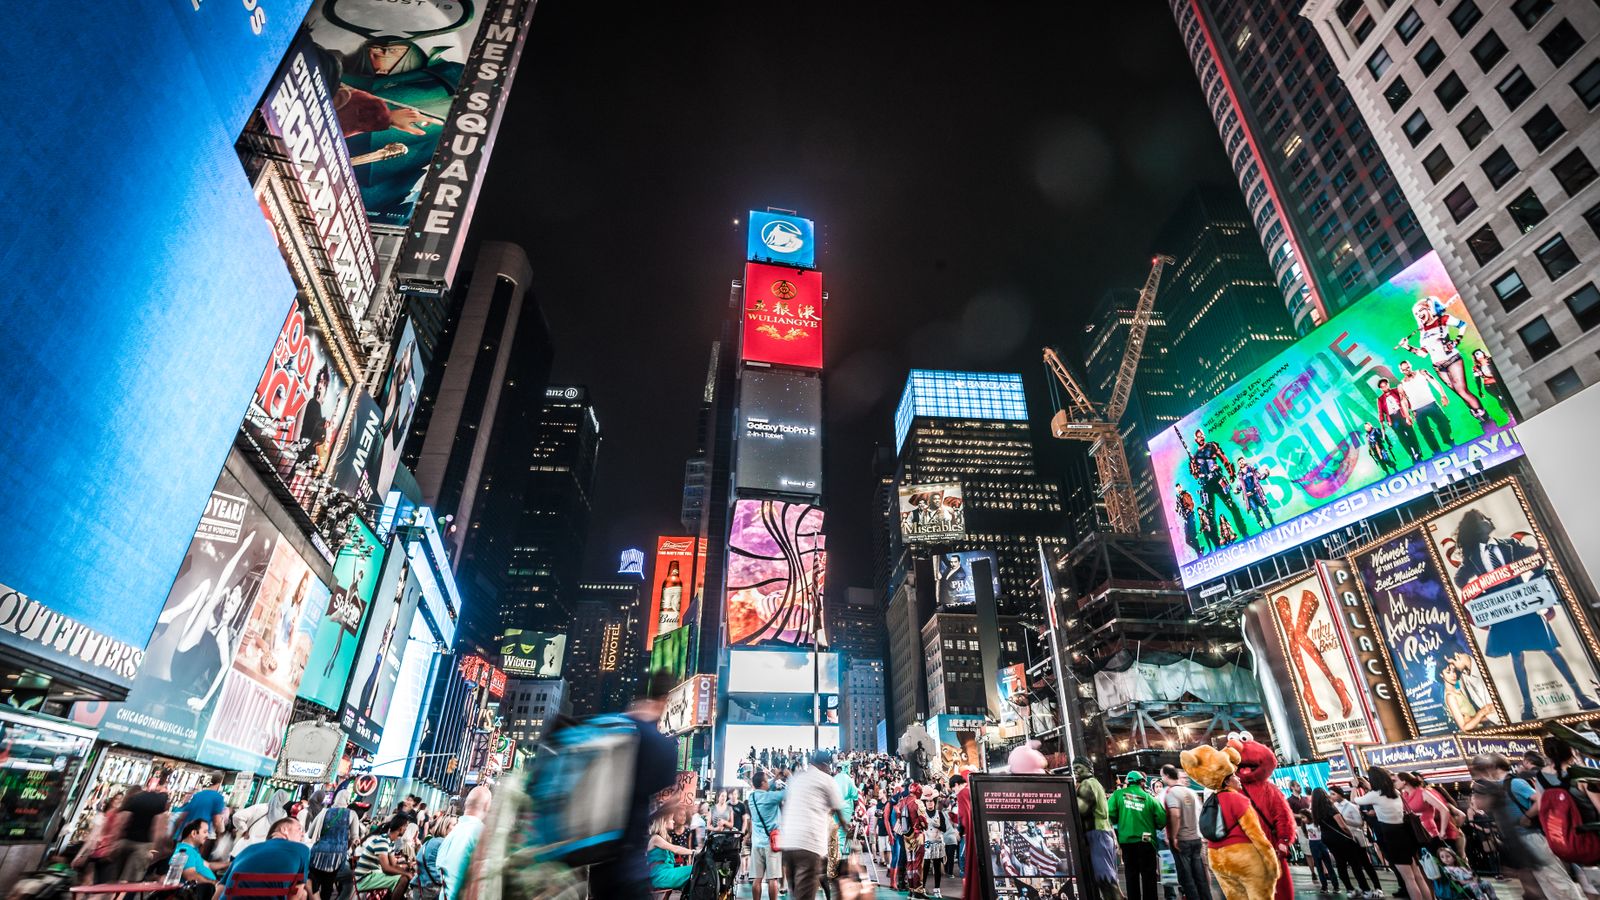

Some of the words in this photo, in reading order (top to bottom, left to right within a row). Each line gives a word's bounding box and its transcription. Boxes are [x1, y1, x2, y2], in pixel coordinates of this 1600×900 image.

[477, 0, 517, 80] IMES
[270, 72, 299, 129] THE
[313, 66, 327, 101] TONY
[322, 98, 338, 139] AWARD
[293, 52, 325, 137] CYNTHIA
[319, 127, 341, 185] ERIVO
[282, 99, 337, 238] COLOR
[424, 91, 492, 235] SQUARE
[414, 251, 441, 261] NYC
[748, 313, 818, 328] WULIANGYE
[967, 380, 1016, 390] BARCLAYS
[747, 422, 778, 433] Galaxy
[353, 410, 379, 478] NEW
[212, 497, 245, 521] YEARS
[1184, 543, 1247, 578] EXPERIENCE
[1246, 539, 1257, 552] IT
[1259, 533, 1273, 549] IN
[1275, 506, 1331, 541] IMAX
[1333, 493, 1368, 517] 3D
[1370, 466, 1428, 502] NOW
[1371, 538, 1409, 568] Winner!
[1374, 575, 1394, 592] Best
[1393, 561, 1426, 583] Musical!
[1462, 584, 1481, 600] FINAL
[1478, 567, 1511, 589] MONTHS
[1387, 590, 1408, 621] An
[1470, 595, 1506, 613] PEDESTRIAN
[1505, 590, 1523, 602] FLOW
[1523, 583, 1542, 596] ZONE
[1384, 606, 1457, 649] American
[1475, 612, 1489, 623] KEEP
[1490, 605, 1513, 618] MOVING
[0, 591, 142, 680] OUTFITTERS
[606, 623, 621, 671] NOVOTEL
[1335, 569, 1391, 701] PALACE
[1404, 630, 1443, 664] Paris
[1536, 692, 1571, 705] Matilda
[116, 708, 198, 740] CHICAGOTHEMUSICAL.COM
[949, 719, 965, 727] ICE
[1336, 721, 1348, 731] TONY
[290, 763, 321, 775] Sanrio
[1383, 749, 1417, 766] American
[165, 768, 199, 792] SLAM
